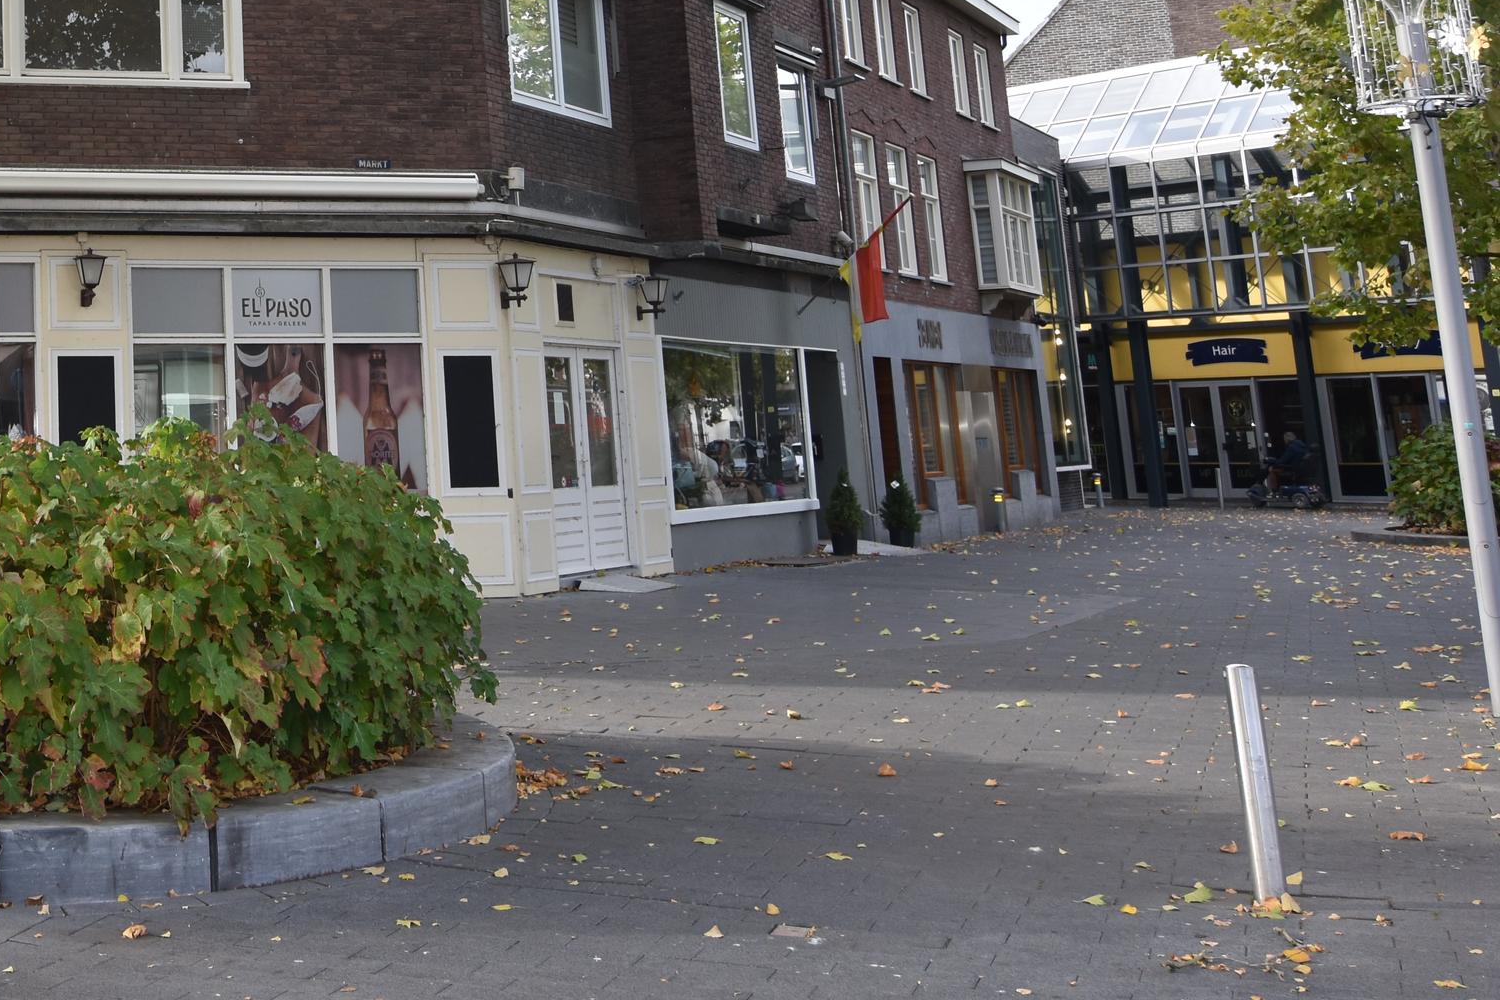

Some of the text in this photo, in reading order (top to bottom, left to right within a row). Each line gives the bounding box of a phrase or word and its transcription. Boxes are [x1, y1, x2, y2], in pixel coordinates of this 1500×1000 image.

[358, 159, 388, 169] MARKT
[241, 297, 312, 318] EL PASO
[1211, 344, 1237, 357] Hair
